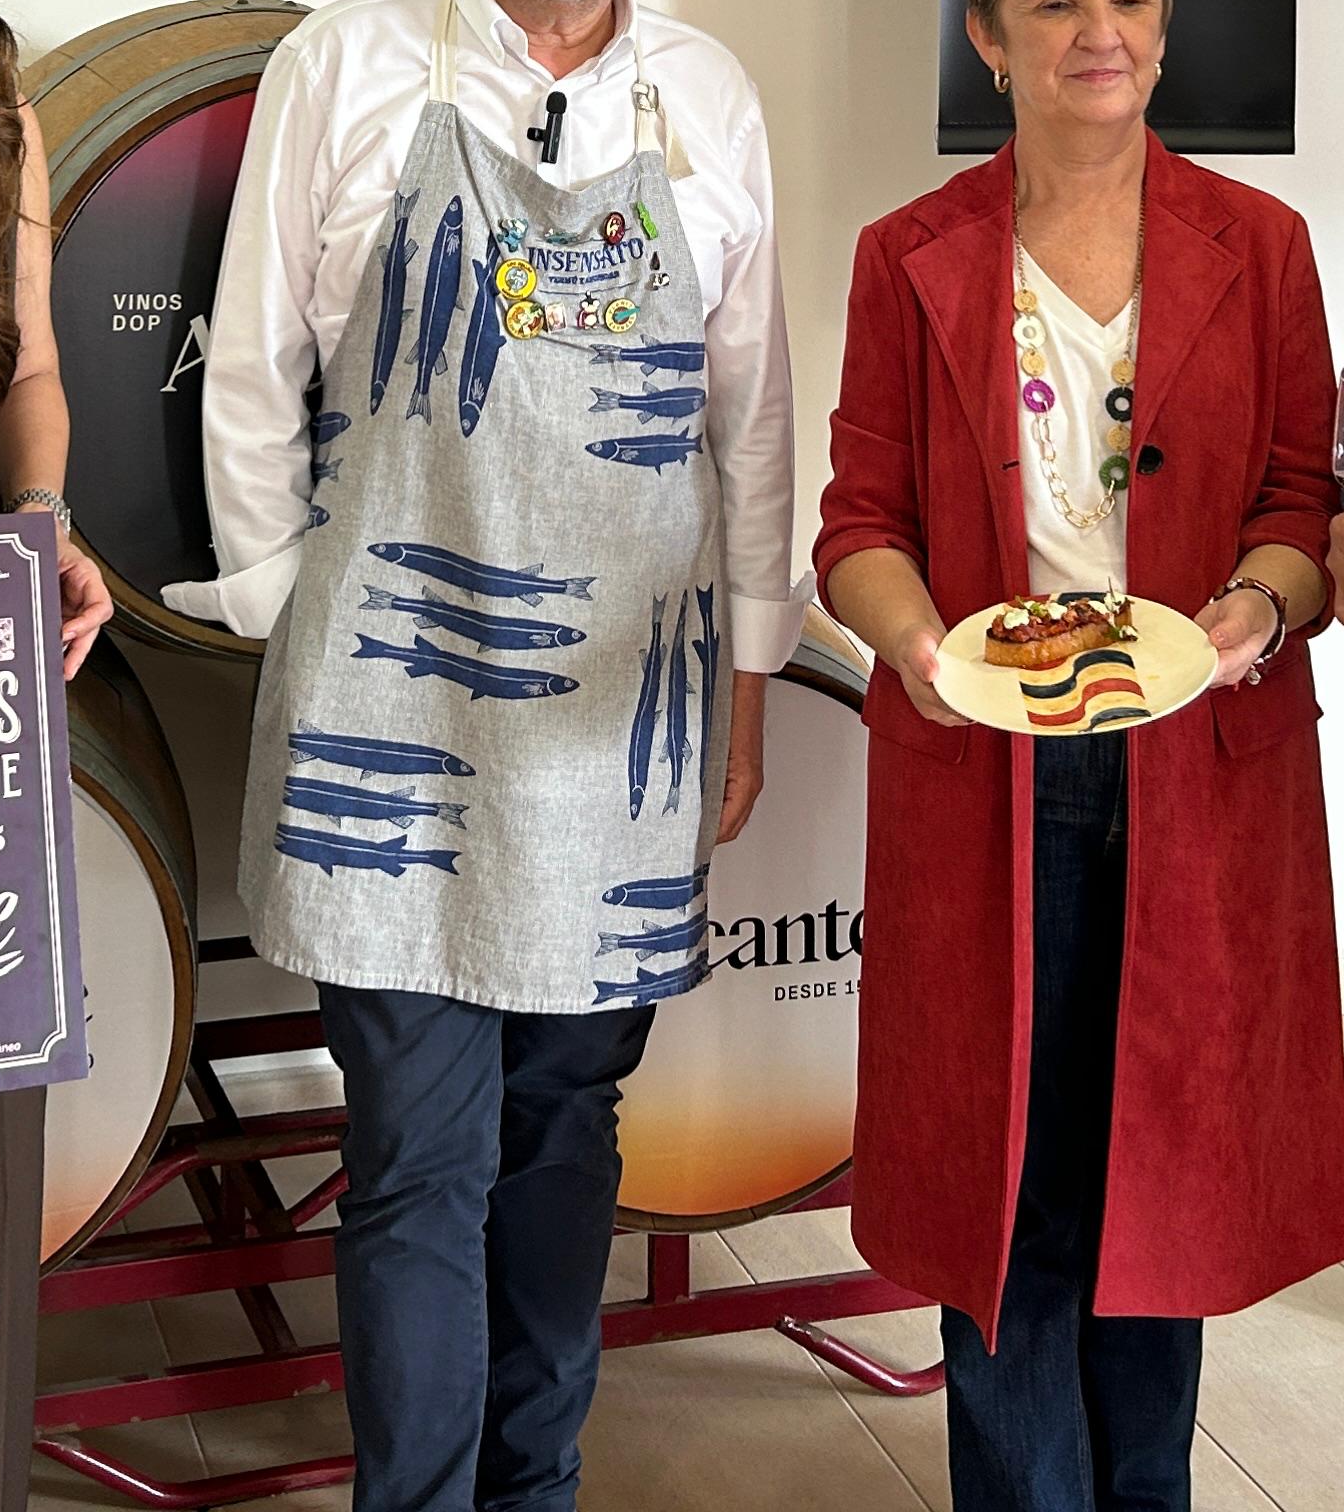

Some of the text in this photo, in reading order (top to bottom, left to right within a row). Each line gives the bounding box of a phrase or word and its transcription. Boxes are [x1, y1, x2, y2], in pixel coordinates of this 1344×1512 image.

[528, 238, 644, 273] INSENSATO
[112, 293, 183, 311] VINOS
[112, 314, 161, 332] DOP
[774, 982, 837, 1001] DESDE
